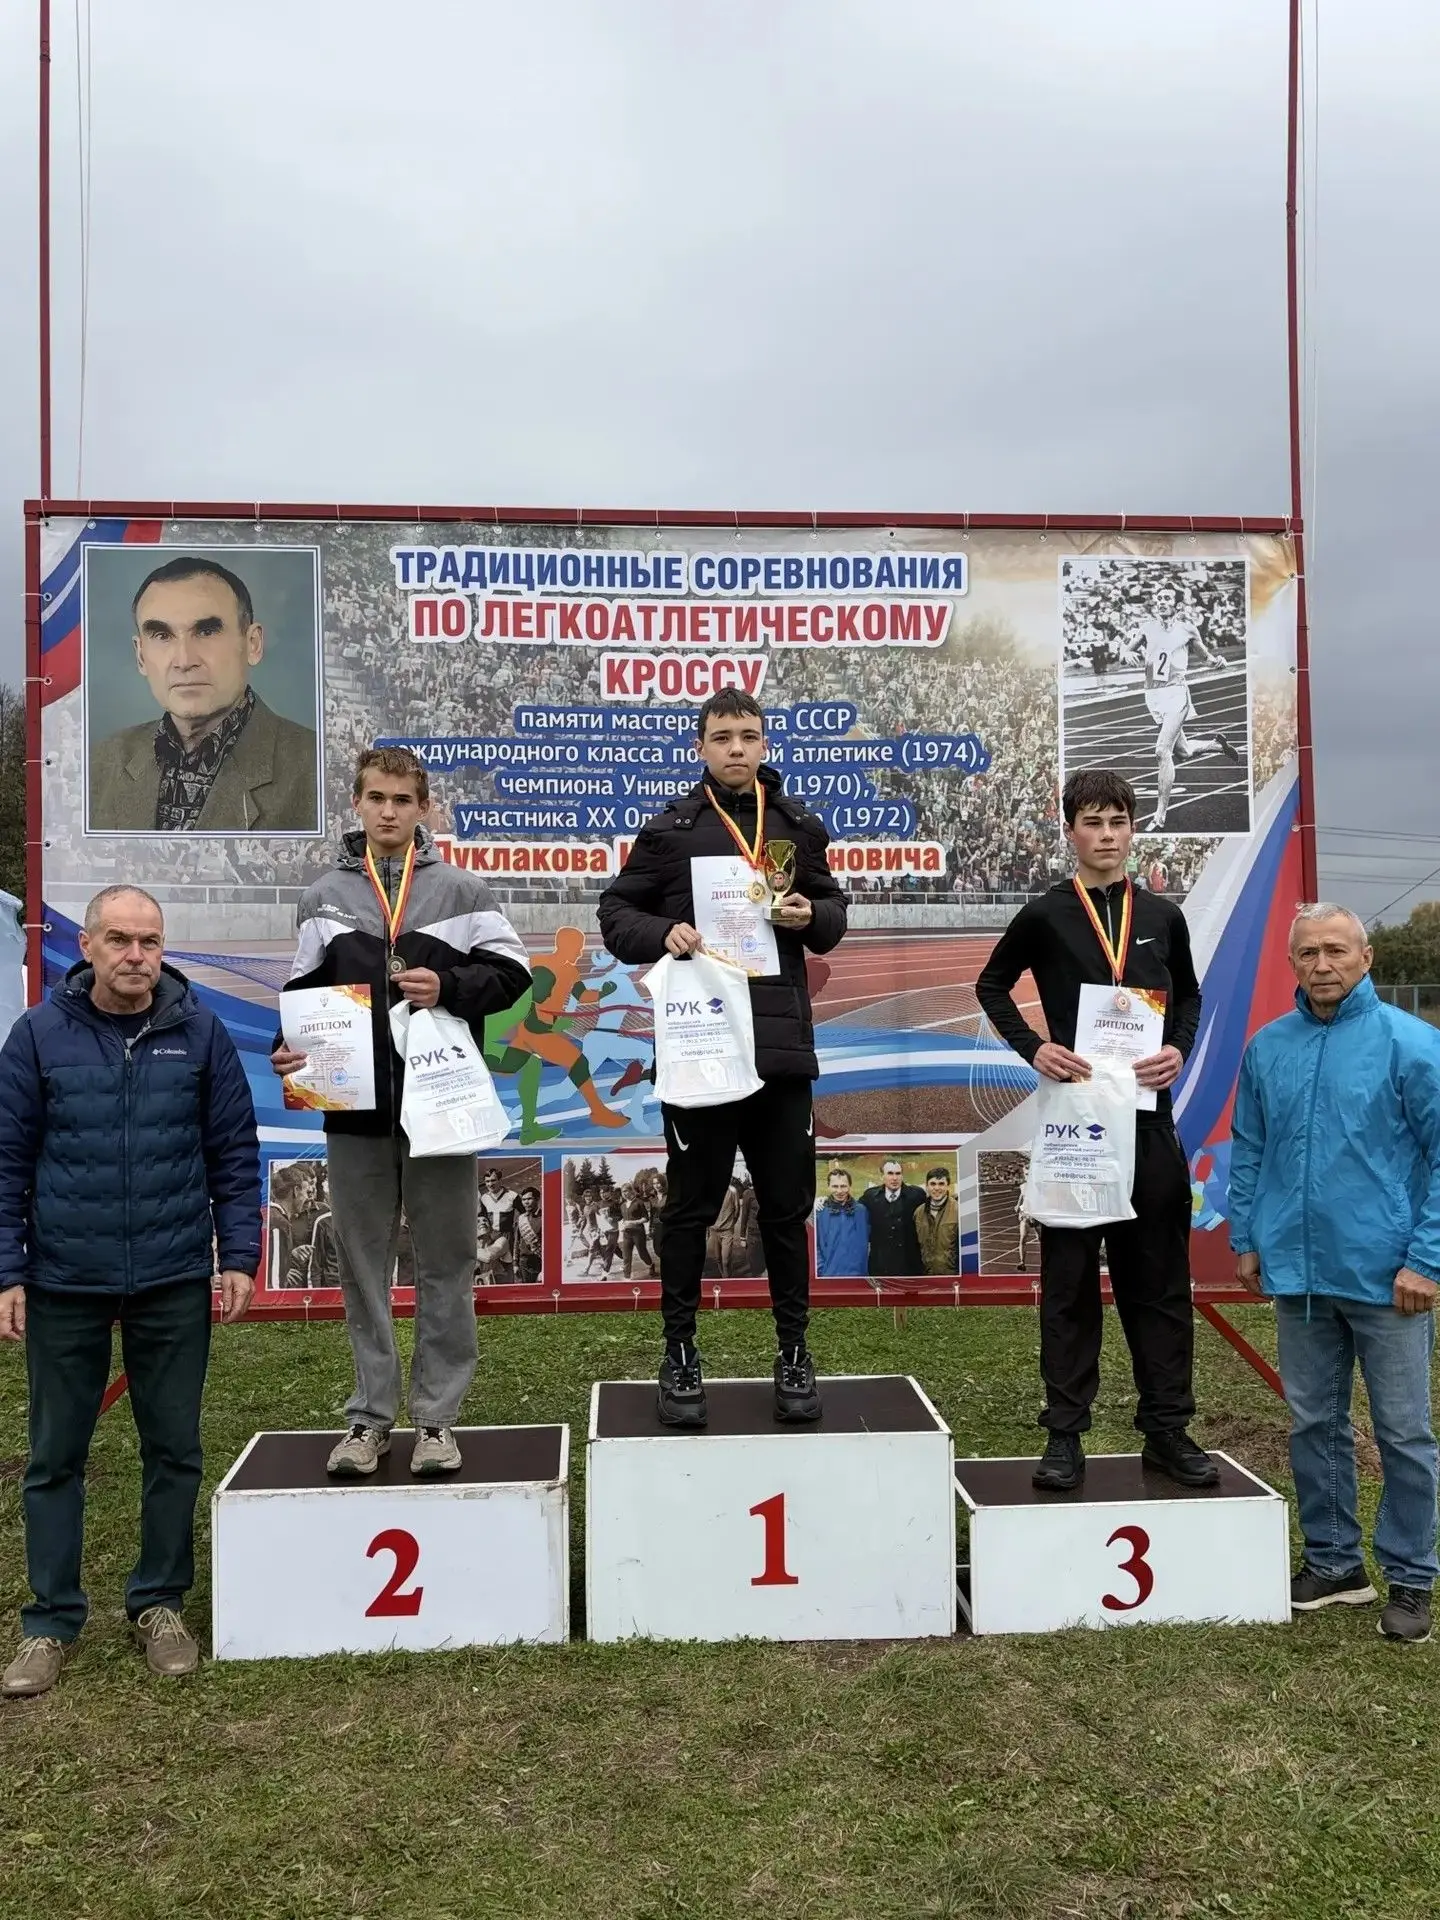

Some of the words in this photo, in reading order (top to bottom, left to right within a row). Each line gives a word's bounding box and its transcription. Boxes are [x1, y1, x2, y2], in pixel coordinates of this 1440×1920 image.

[397, 552, 682, 591] ТРАДИЦИОННЫЕ
[696, 556, 963, 590] СОРЕВНОВАНИЯ
[415, 600, 465, 636] ПО
[481, 602, 948, 642] ЛЕГКОАТЛЕТИЧЕСКОМУ
[1157, 652, 1167, 676] 2
[606, 658, 763, 697] КРОССУ
[521, 712, 602, 729] памяти
[612, 713, 699, 735] мастера
[795, 708, 850, 731] СССР
[379, 744, 578, 766] ждународного
[588, 745, 663, 763] класса
[673, 747, 700, 763] по
[792, 747, 893, 763] атлетике
[902, 740, 985, 767] (1974),
[501, 778, 613, 796] чемпиона
[783, 774, 869, 800] (1970),
[460, 810, 577, 831] участника
[832, 806, 910, 833] (1972)
[828, 847, 940, 872] новича
[711, 889, 750, 901] ДИПЛО
[665, 1001, 702, 1017] РУК
[300, 1020, 352, 1034] ДИПЛОМ
[1094, 1019, 1144, 1032] ДИПЛОМ
[409, 1047, 449, 1071] РУК
[1045, 1124, 1081, 1139] РУК
[749, 1492, 799, 1586] 1
[365, 1528, 424, 1617] 2
[1101, 1525, 1154, 1611] 3
